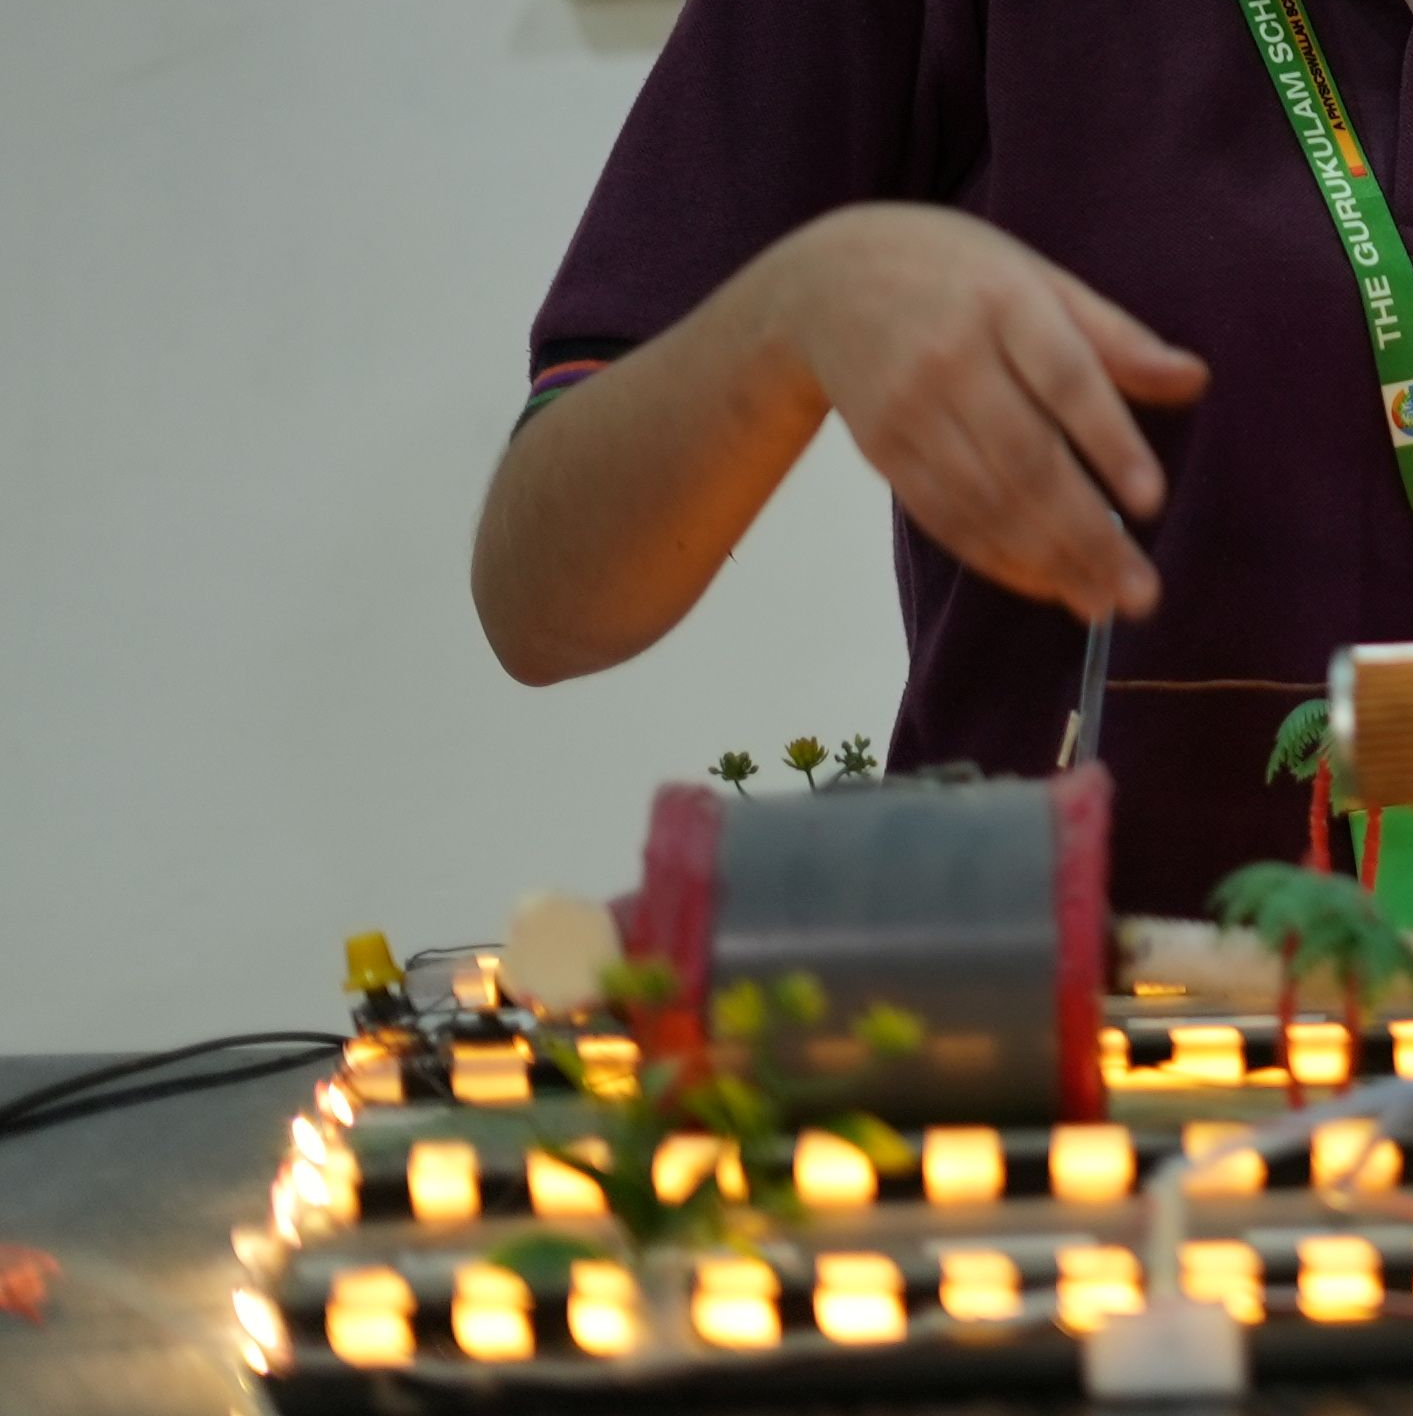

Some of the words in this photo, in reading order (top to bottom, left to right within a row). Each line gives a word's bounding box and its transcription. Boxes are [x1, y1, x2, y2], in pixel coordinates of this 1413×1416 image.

[1333, 121, 1346, 132] A
[1279, 71, 1380, 267] GURUKULAM
[1364, 275, 1402, 351] THE
